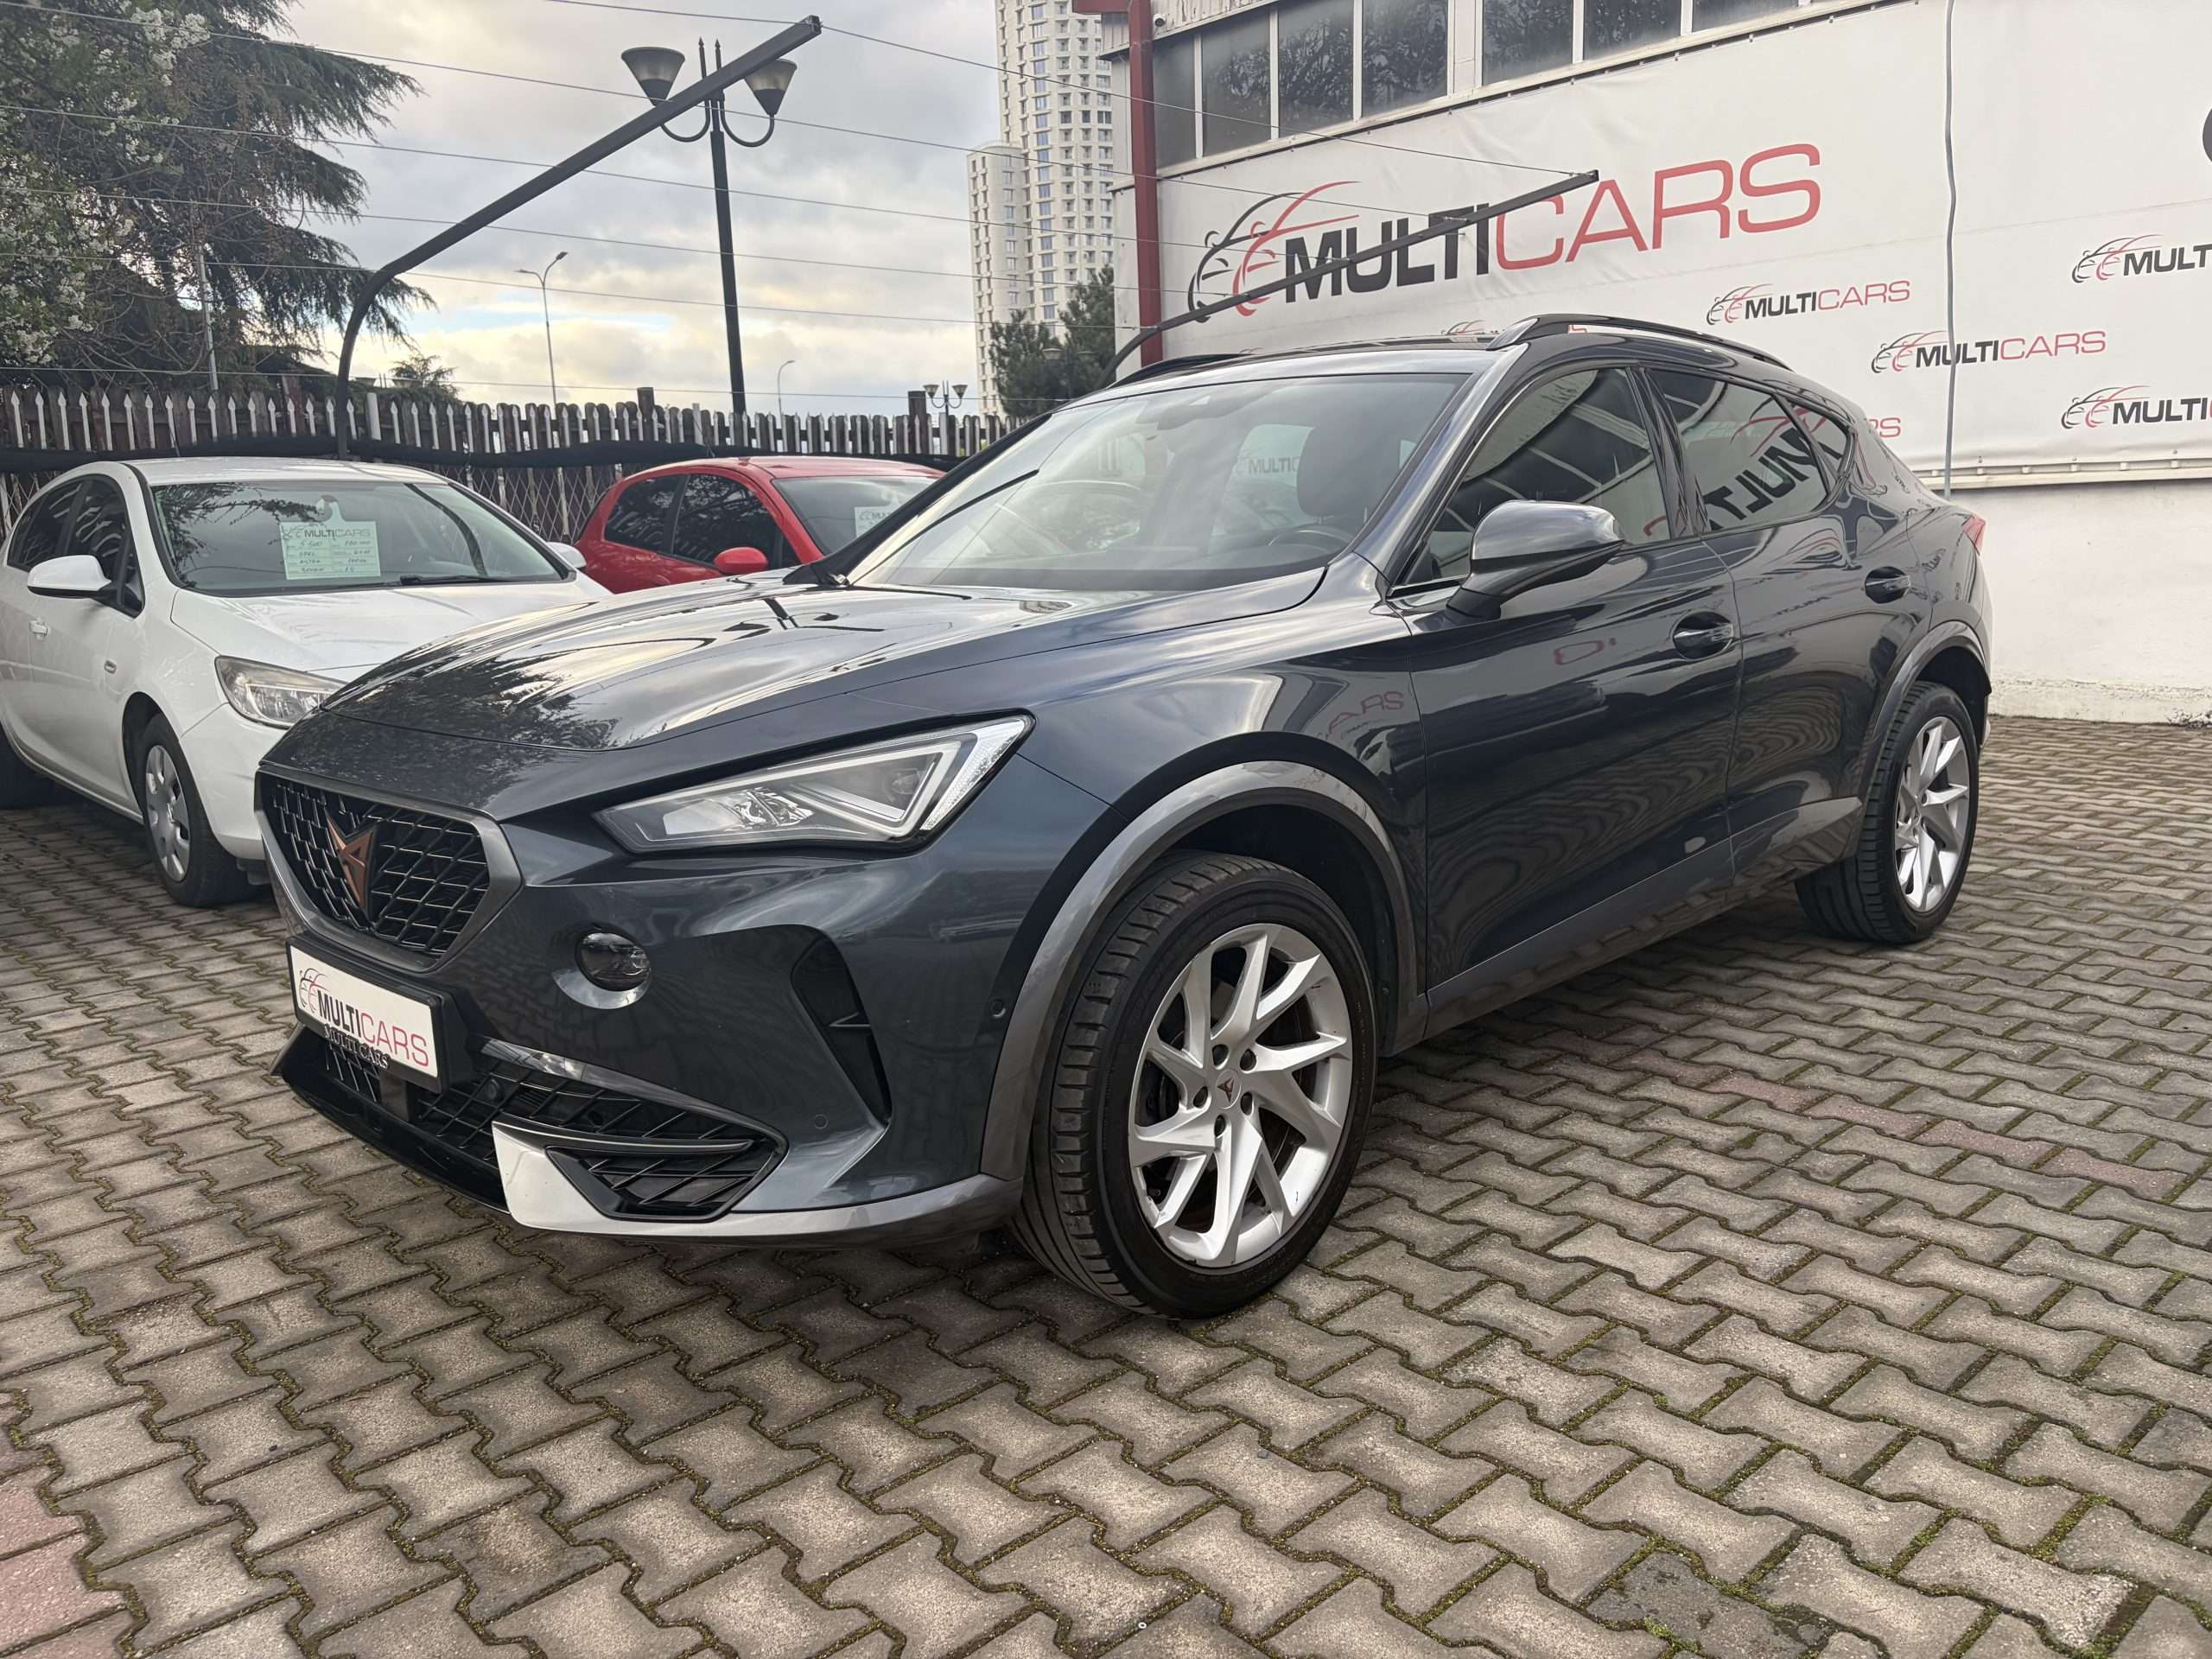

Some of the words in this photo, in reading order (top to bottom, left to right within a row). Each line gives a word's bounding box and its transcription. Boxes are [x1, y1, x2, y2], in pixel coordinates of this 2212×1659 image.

[1285, 143, 1821, 304] MULTICARS
[1745, 280, 1910, 320] MULTICARS
[1915, 331, 2107, 369] MULTICARS
[2113, 397, 2212, 424] MULTI
[304, 528, 372, 538] MULTICARS
[317, 989, 429, 1067] MULTICARS
[324, 1023, 359, 1056] MULTI
[359, 1042, 390, 1070] CARS
